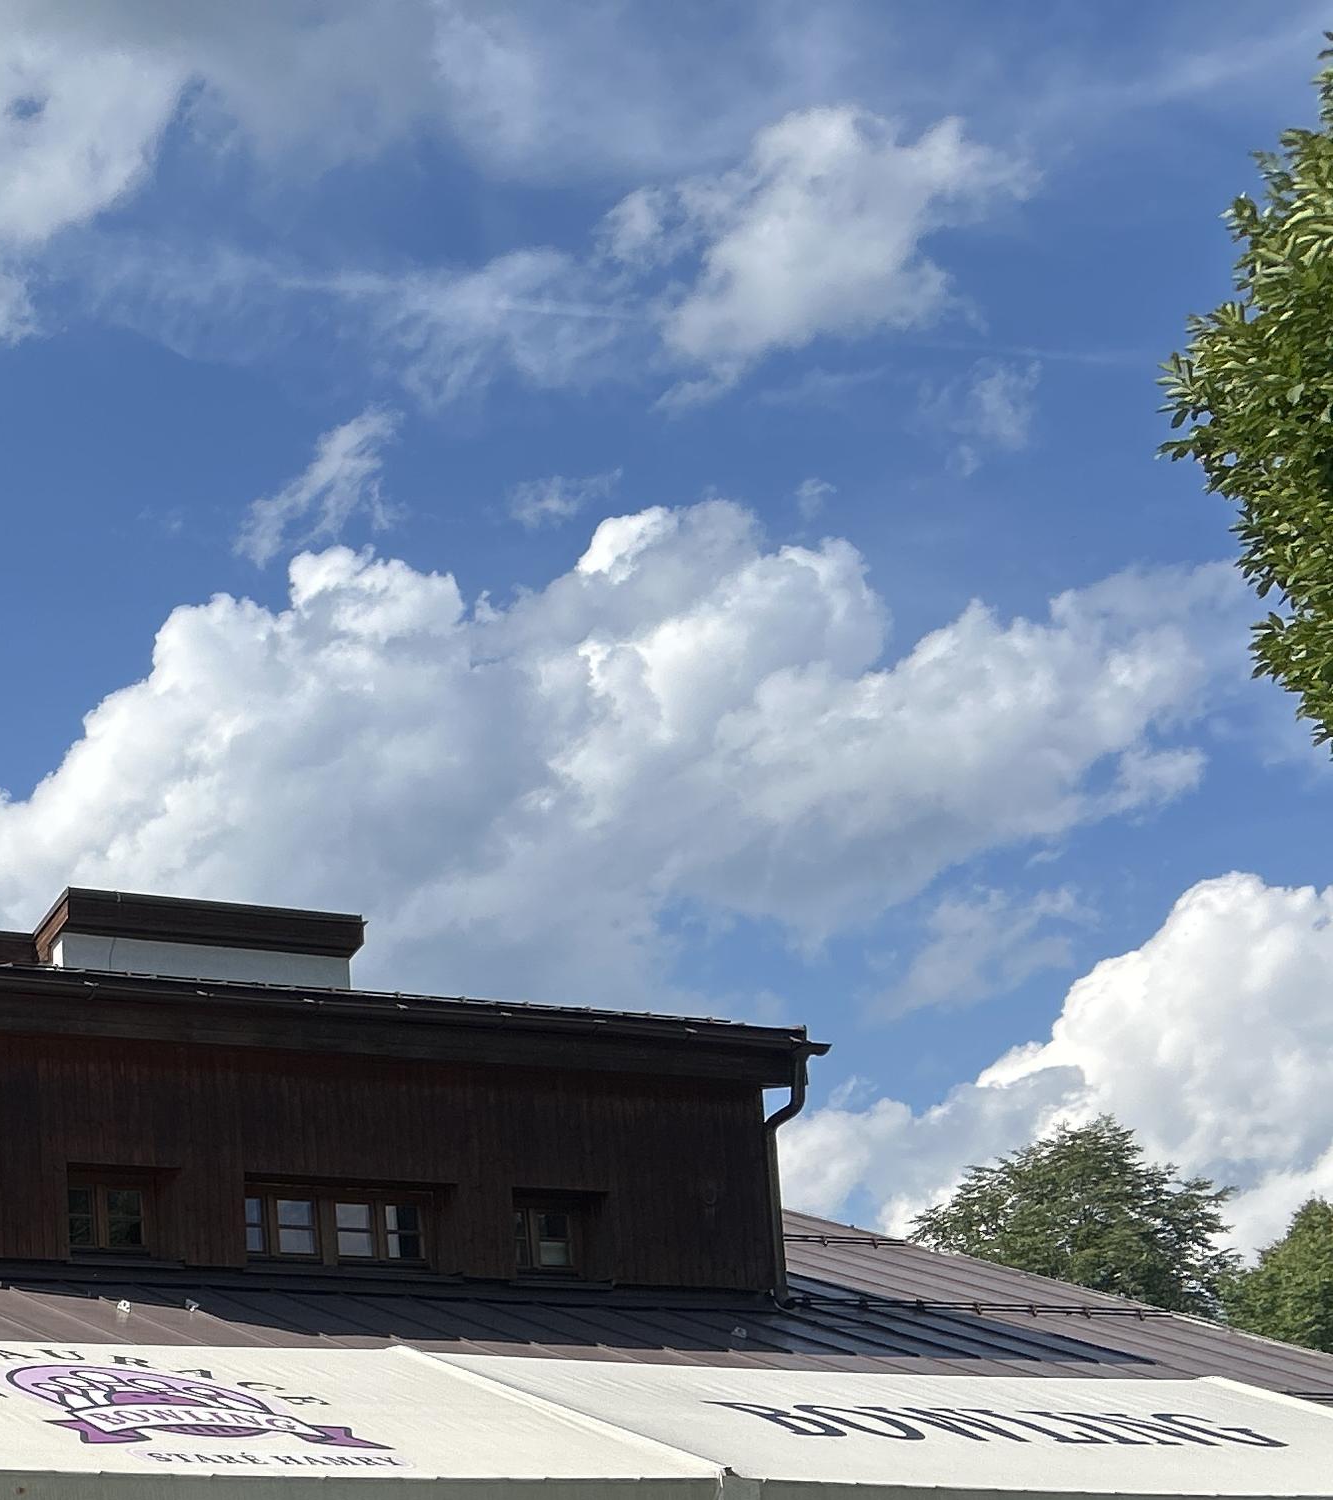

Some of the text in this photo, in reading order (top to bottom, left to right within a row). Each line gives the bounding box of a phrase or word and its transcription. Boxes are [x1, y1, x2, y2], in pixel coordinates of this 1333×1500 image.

[93, 1408, 298, 1434] BOWLING
[700, 1400, 1289, 1447] BOWLING
[146, 1448, 404, 1468] STARÉ HAMRY
